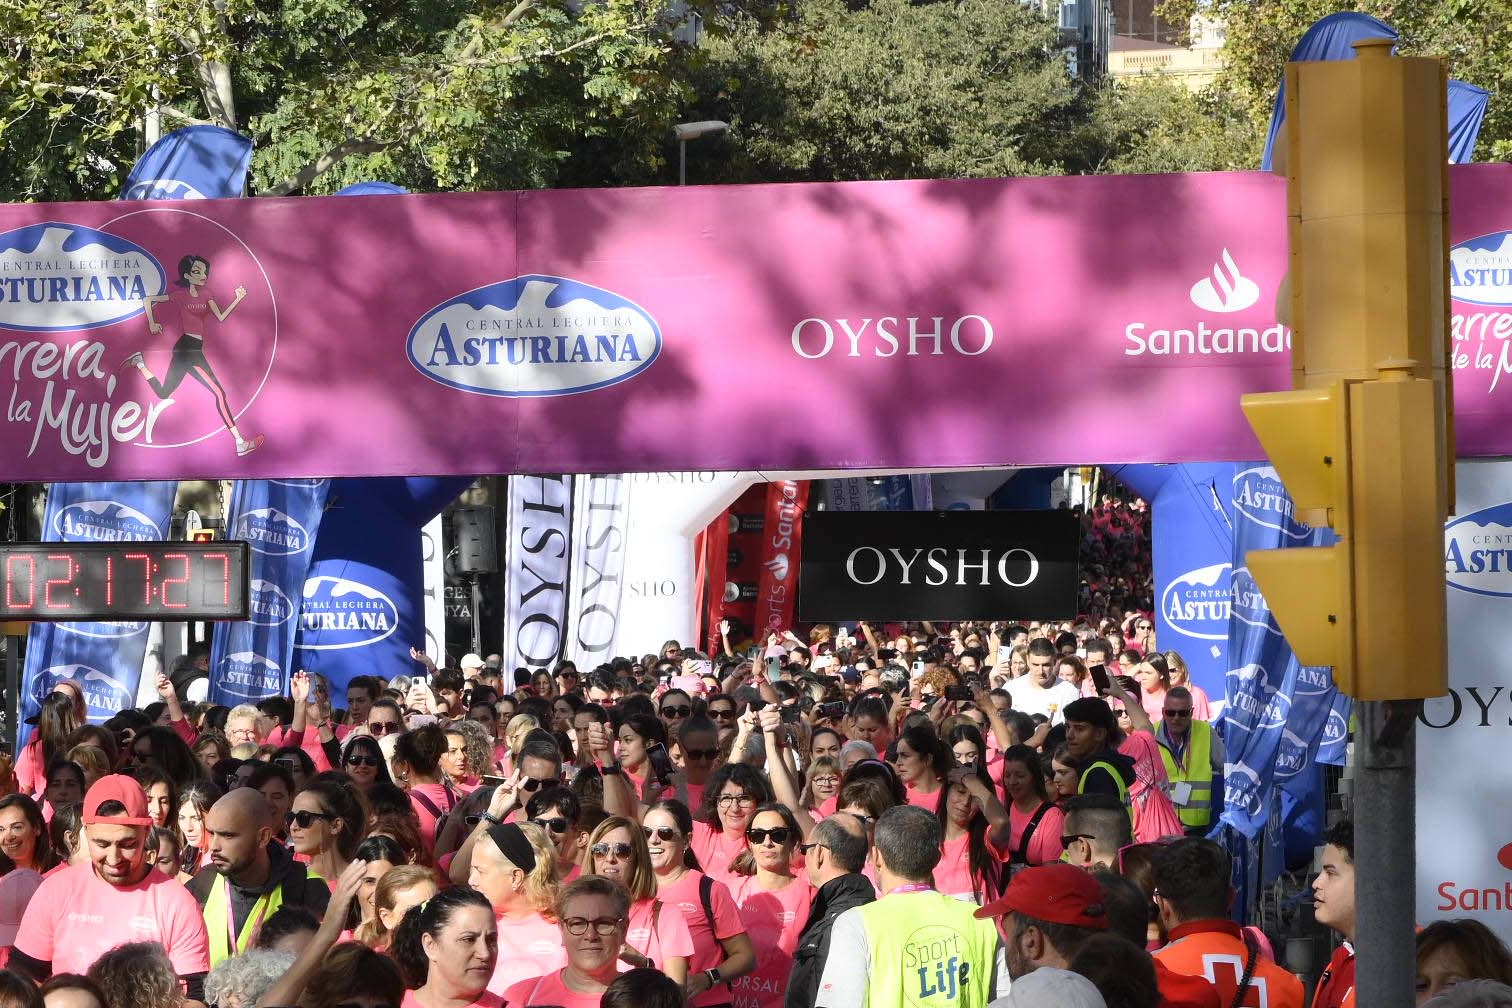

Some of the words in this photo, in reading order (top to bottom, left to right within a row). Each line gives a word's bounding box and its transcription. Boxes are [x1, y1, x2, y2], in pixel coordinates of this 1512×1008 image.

[69, 257, 141, 270] LECHERA
[465, 318, 544, 331] CENTRAL
[552, 315, 633, 328] LECHERA
[791, 314, 995, 359] OYSHO
[1125, 321, 1291, 355] Santand
[1451, 312, 1512, 341] arre
[426, 322, 642, 367] ASTURIANA
[1475, 341, 1493, 369] la
[6, 382, 32, 423] la
[27, 374, 175, 468] Mujer
[1256, 482, 1285, 493] CENT
[239, 523, 300, 550] ASTRIANA
[846, 546, 1040, 587] OYSHO
[335, 600, 385, 609] LECHERA
[1417, 686, 1512, 728] OY
[905, 933, 960, 968] Sport
[918, 956, 970, 999] Life
